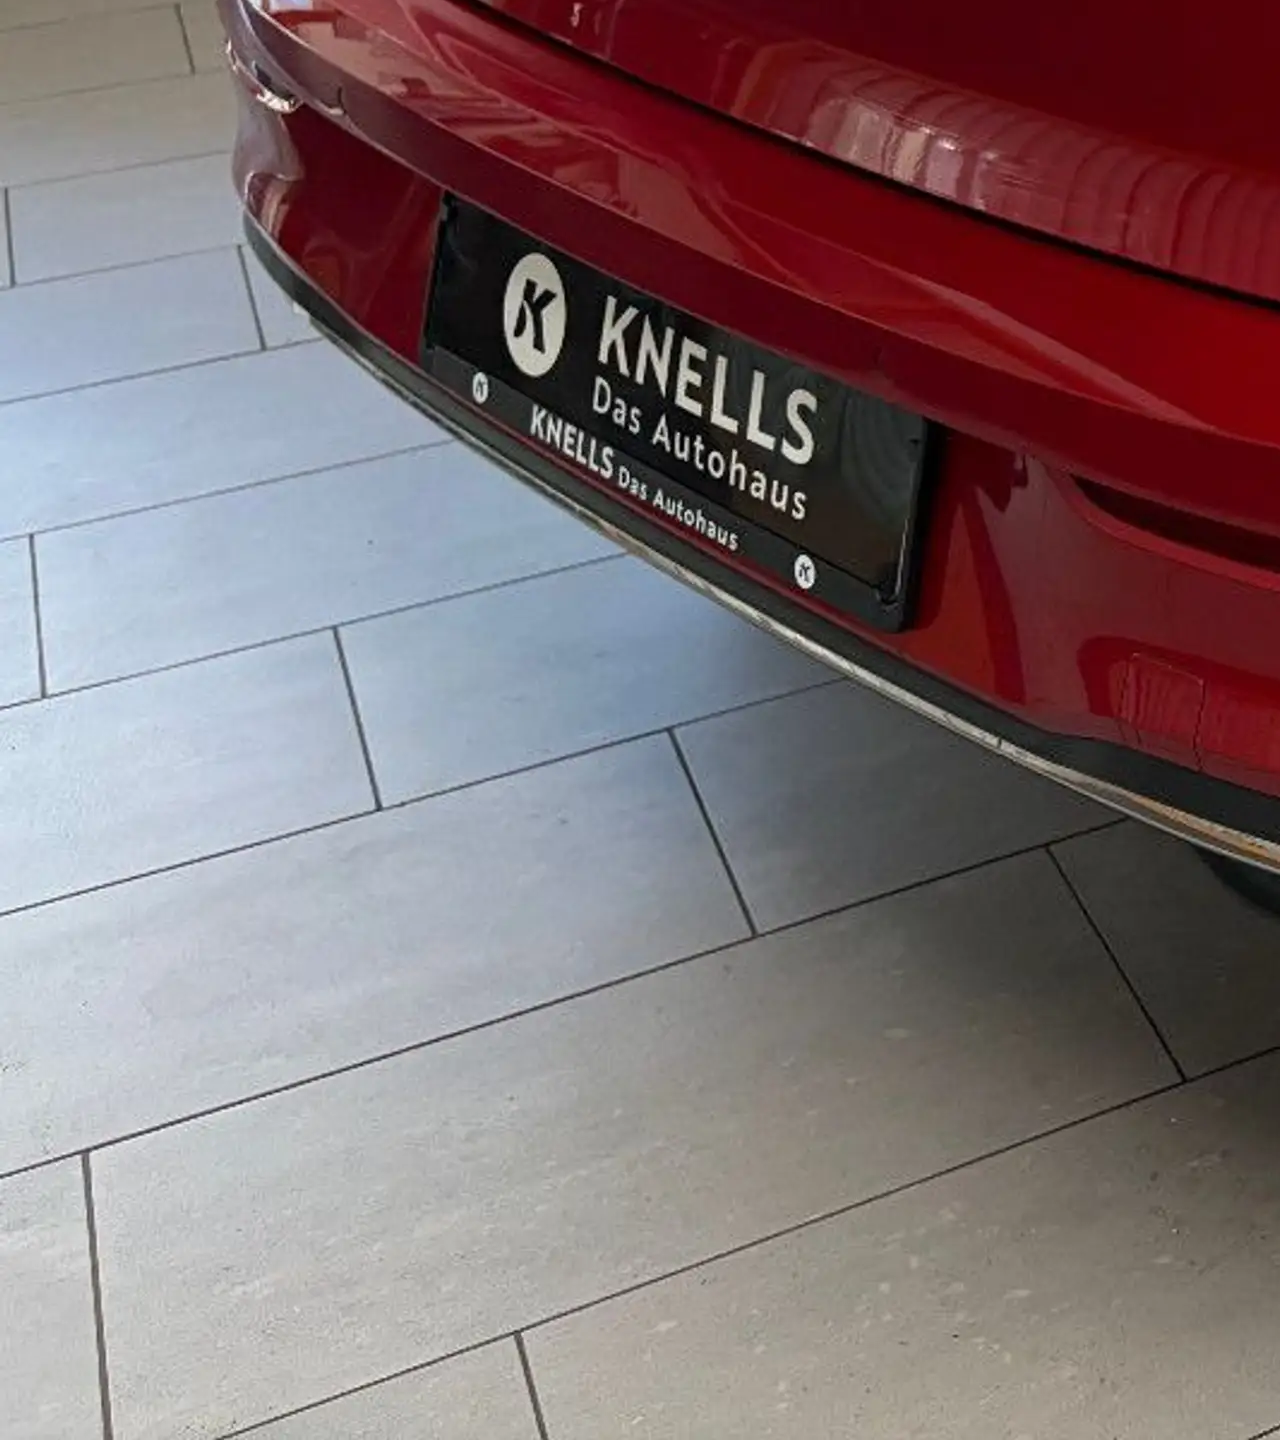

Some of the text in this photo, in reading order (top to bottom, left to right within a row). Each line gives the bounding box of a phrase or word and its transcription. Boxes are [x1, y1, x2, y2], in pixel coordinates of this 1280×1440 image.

[591, 376, 807, 520] Das Autohaus
[598, 296, 818, 466] KNELLS
[530, 406, 614, 479] KNELLS
[618, 466, 648, 501] Das
[652, 488, 739, 552] Autohaus
